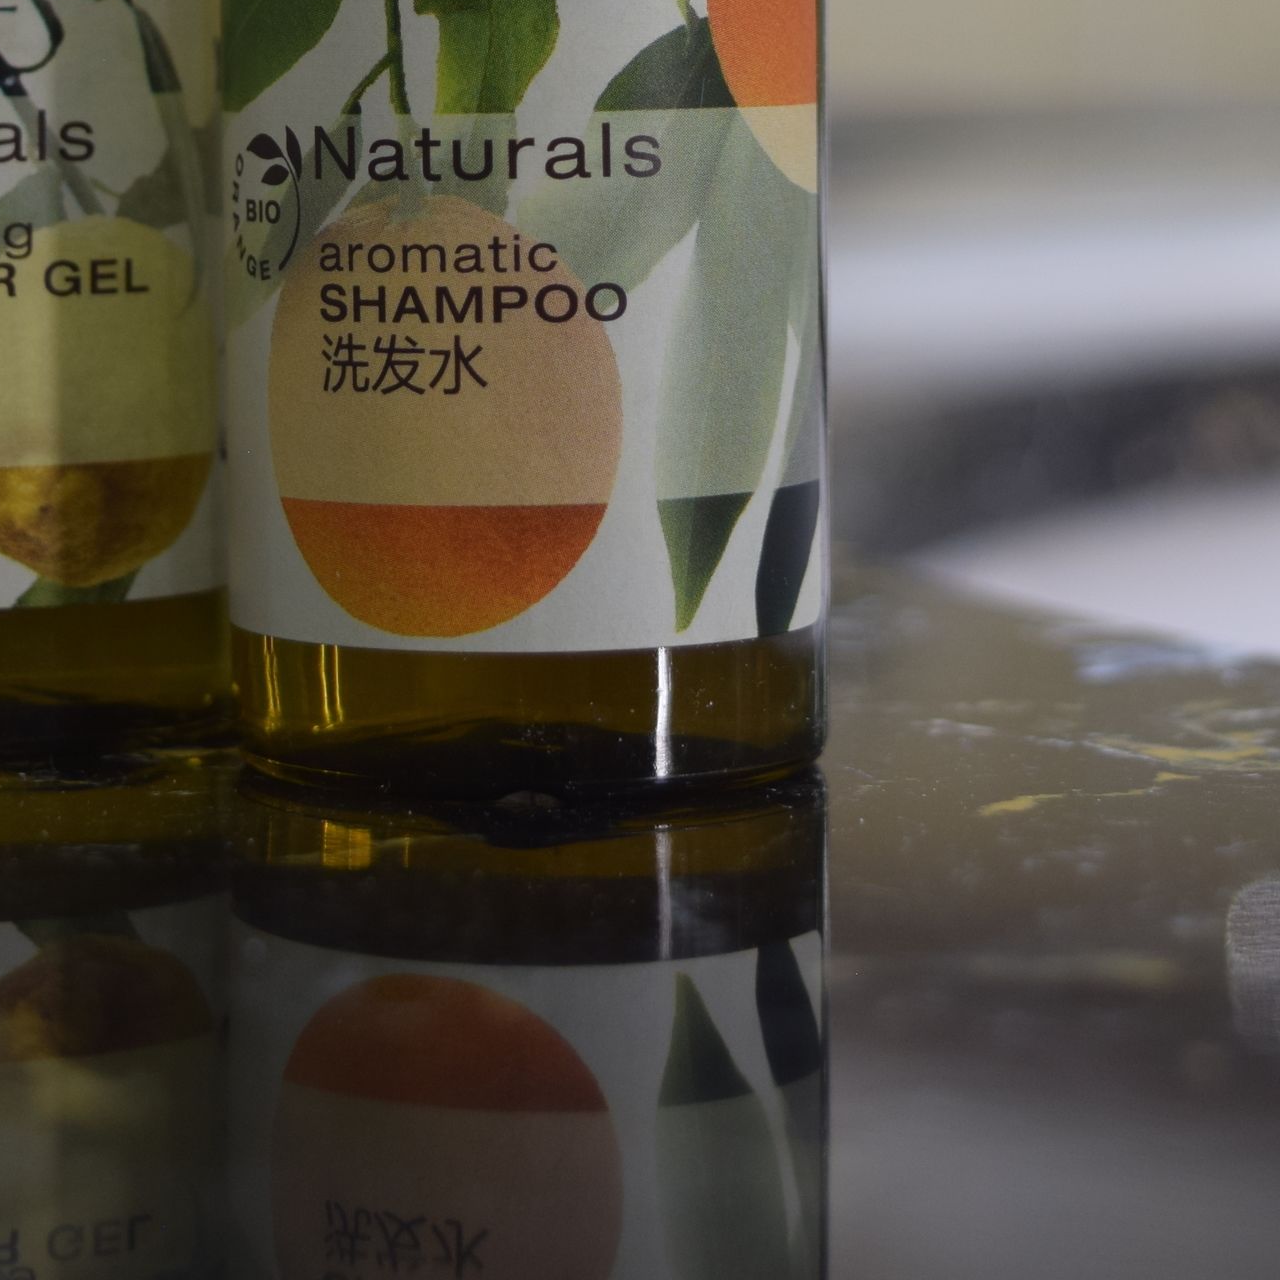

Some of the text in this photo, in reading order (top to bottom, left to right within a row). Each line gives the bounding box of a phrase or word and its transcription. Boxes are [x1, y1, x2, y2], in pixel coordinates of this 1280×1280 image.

[313, 121, 663, 183] Naturals
[231, 152, 273, 282] ORANGE
[245, 198, 281, 225] BIO
[320, 234, 559, 274] aromatic
[44, 258, 150, 296] GEL
[320, 281, 628, 325] SHAMPOO
[321, 333, 489, 396] 洗发水
